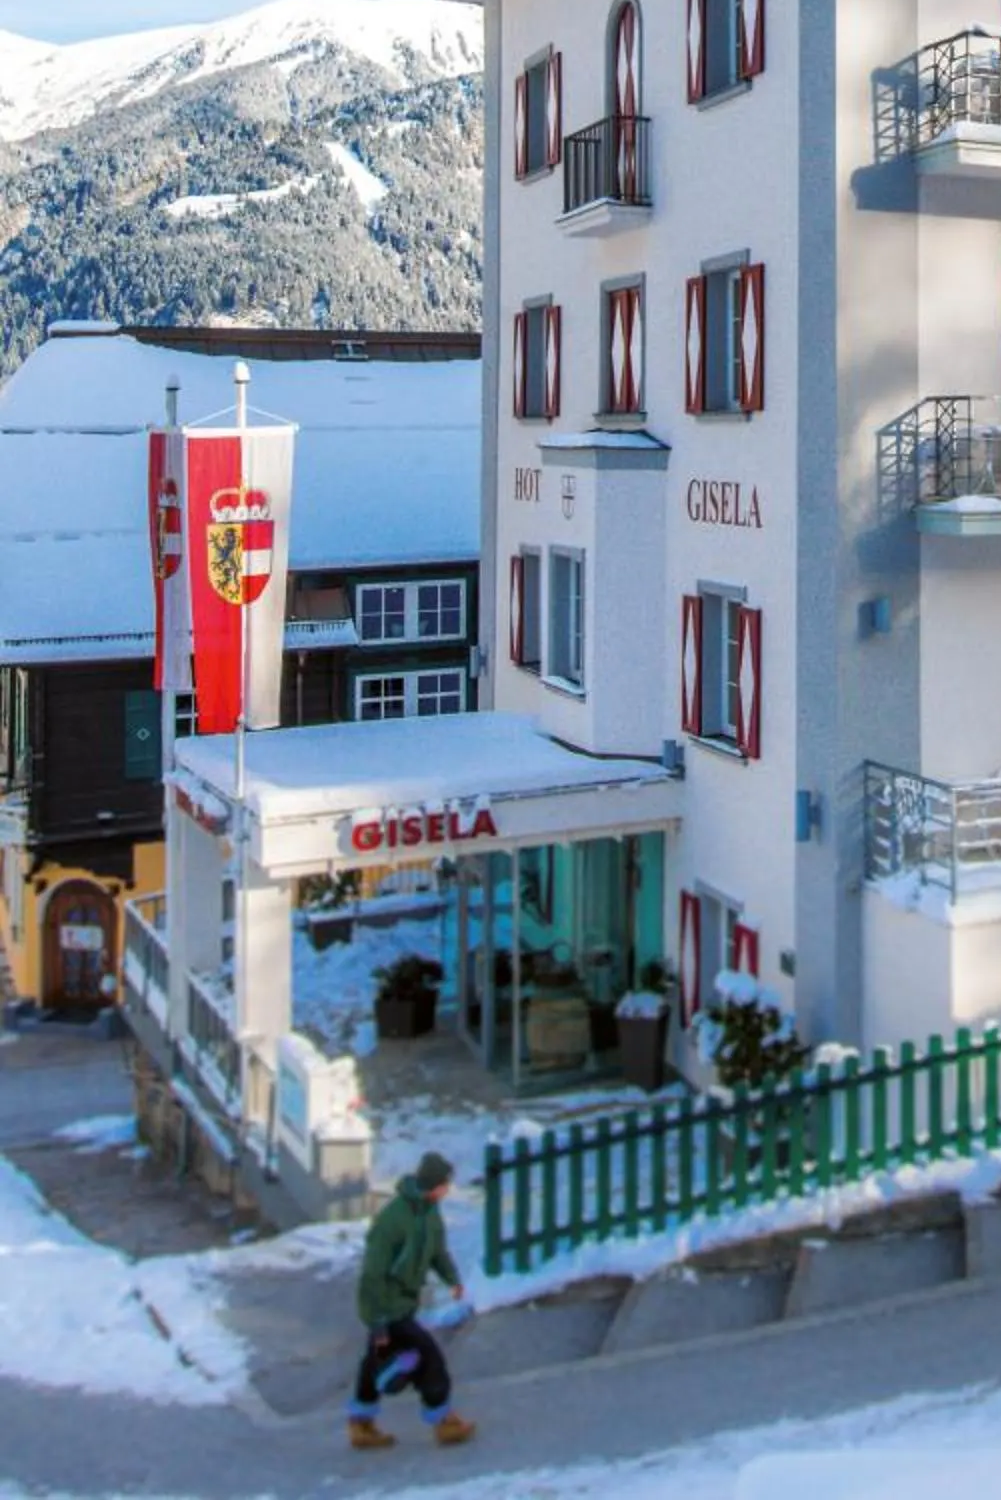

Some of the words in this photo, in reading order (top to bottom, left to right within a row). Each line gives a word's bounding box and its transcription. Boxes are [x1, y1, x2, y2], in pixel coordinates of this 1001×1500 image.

[514, 467, 542, 502] HOT
[687, 478, 763, 529] GISELA
[351, 808, 497, 852] GISELA
